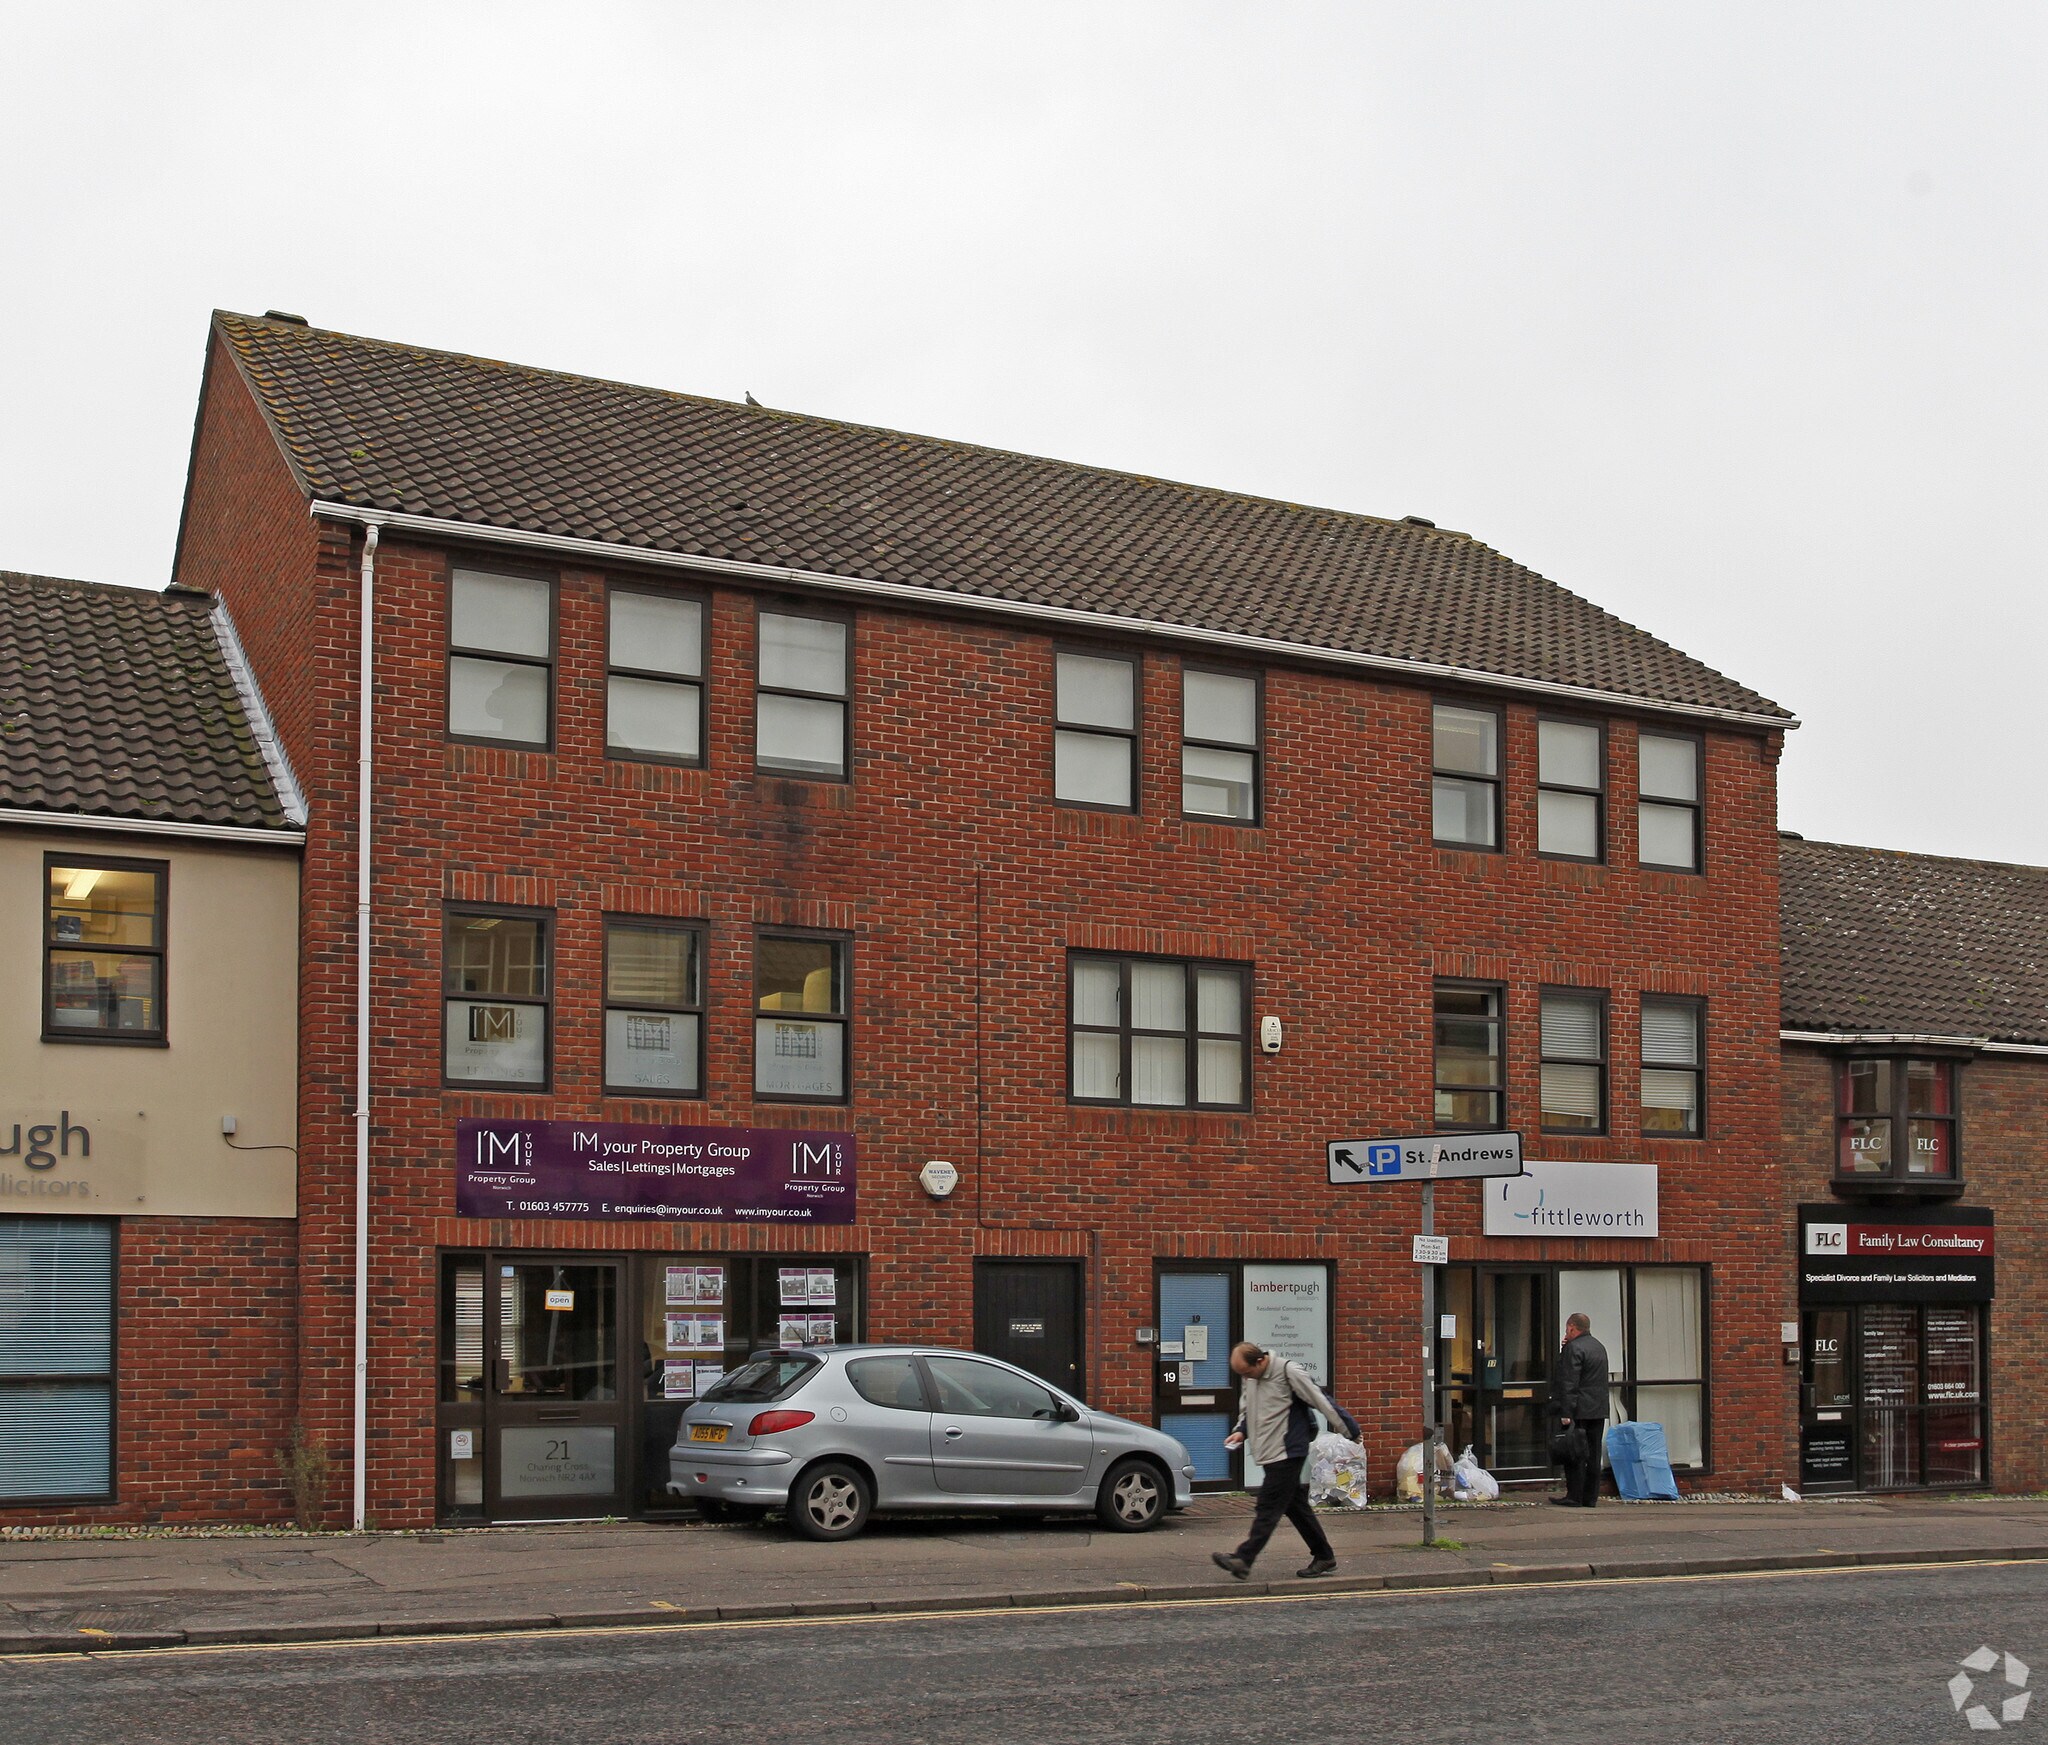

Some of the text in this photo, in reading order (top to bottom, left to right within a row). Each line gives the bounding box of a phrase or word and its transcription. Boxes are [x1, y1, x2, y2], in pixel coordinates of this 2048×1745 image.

[477, 1130, 519, 1166] I'M
[525, 1133, 533, 1166] YOUR
[573, 1131, 751, 1160] I'M your Property Group
[1850, 1137, 1882, 1150] FLC
[1917, 1137, 1939, 1151] FLC
[793, 1141, 830, 1175] I'M
[1376, 1148, 1396, 1173] P
[1438, 1148, 1514, 1163] Andrews
[468, 1174, 536, 1185] Property Group
[784, 1183, 846, 1193] Property Group
[506, 1201, 812, 1218] T. 01603 457775 E. enquiries@imyour.co.uk www.imyour.co.uk
[1531, 1207, 1644, 1226] fittleworth
[1815, 1232, 1985, 1252] FLC Family Law Consultancy
[1805, 1273, 1977, 1284] Specialist Divorce and Family Law Solicitors and Mediators
[1250, 1281, 1320, 1295] lambertpugh
[1191, 1314, 1201, 1323] 19
[1815, 1339, 1838, 1351] FLC
[1163, 1372, 1176, 1382] 19
[1927, 1391, 1979, 1399] www.flc.uk.com
[545, 1440, 571, 1460] 21
[527, 1462, 561, 1473] Charing
